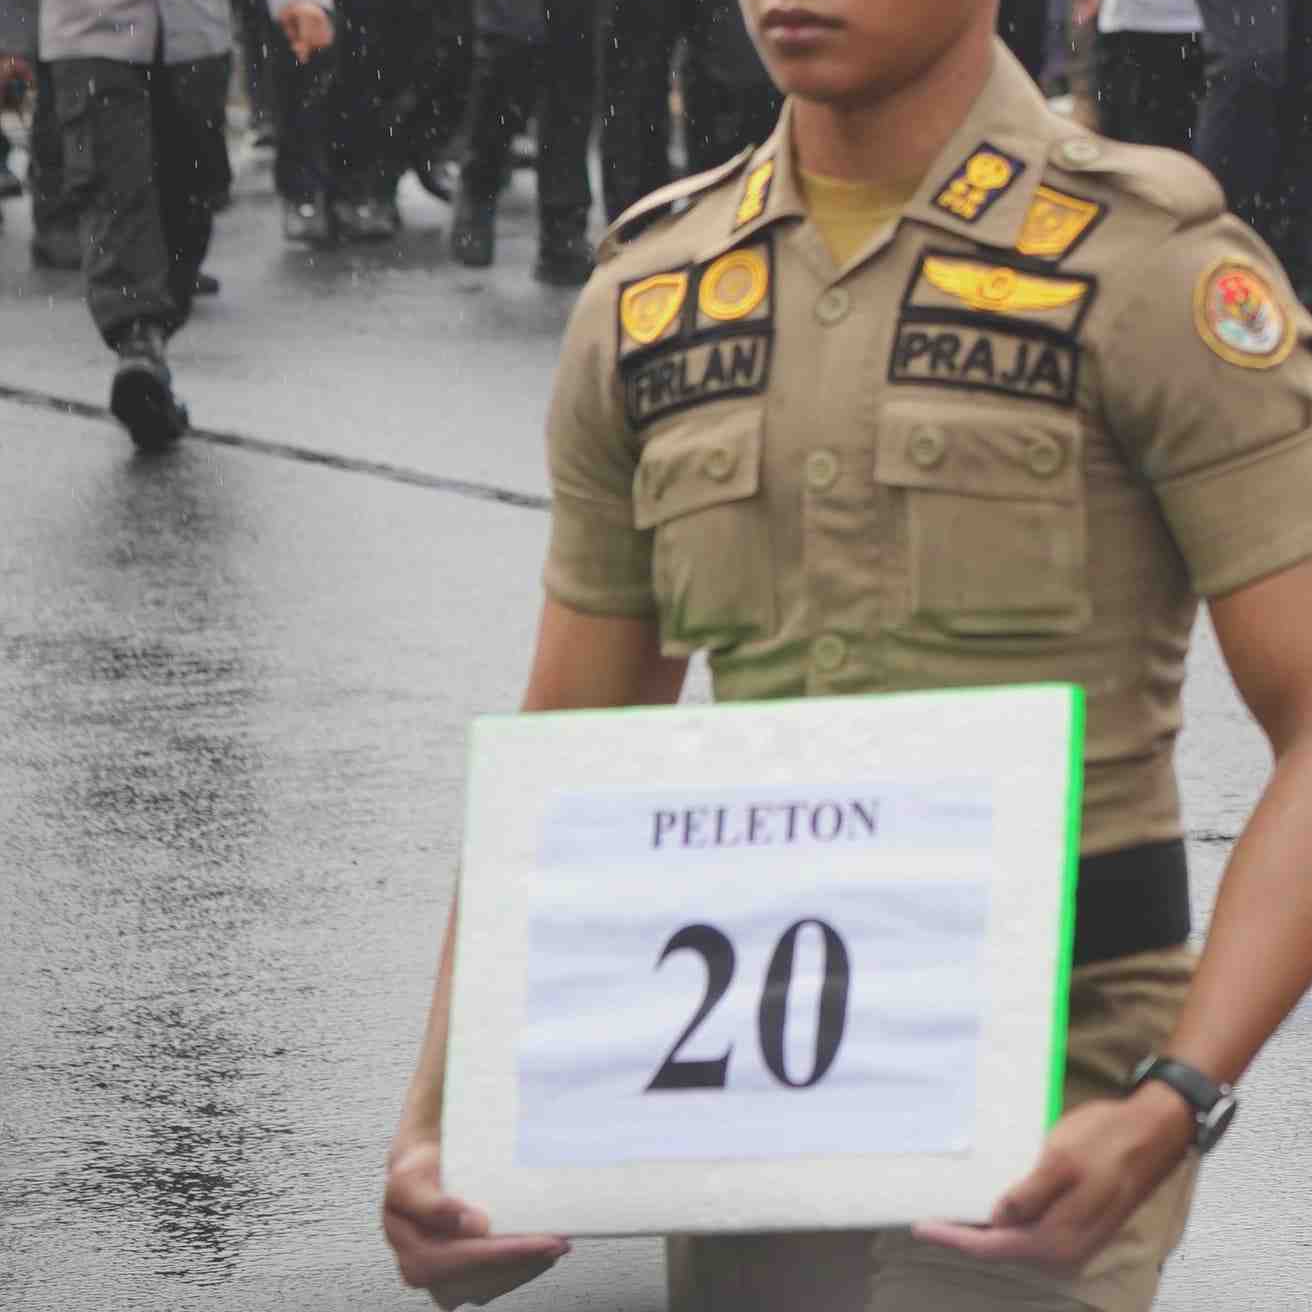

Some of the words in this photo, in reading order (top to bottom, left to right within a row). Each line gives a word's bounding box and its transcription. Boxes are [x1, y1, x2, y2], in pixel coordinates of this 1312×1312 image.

[632, 338, 758, 414] FIRLAN
[896, 331, 1070, 394] PRAJA
[651, 799, 881, 850] PELETON
[642, 917, 851, 1096] 20
